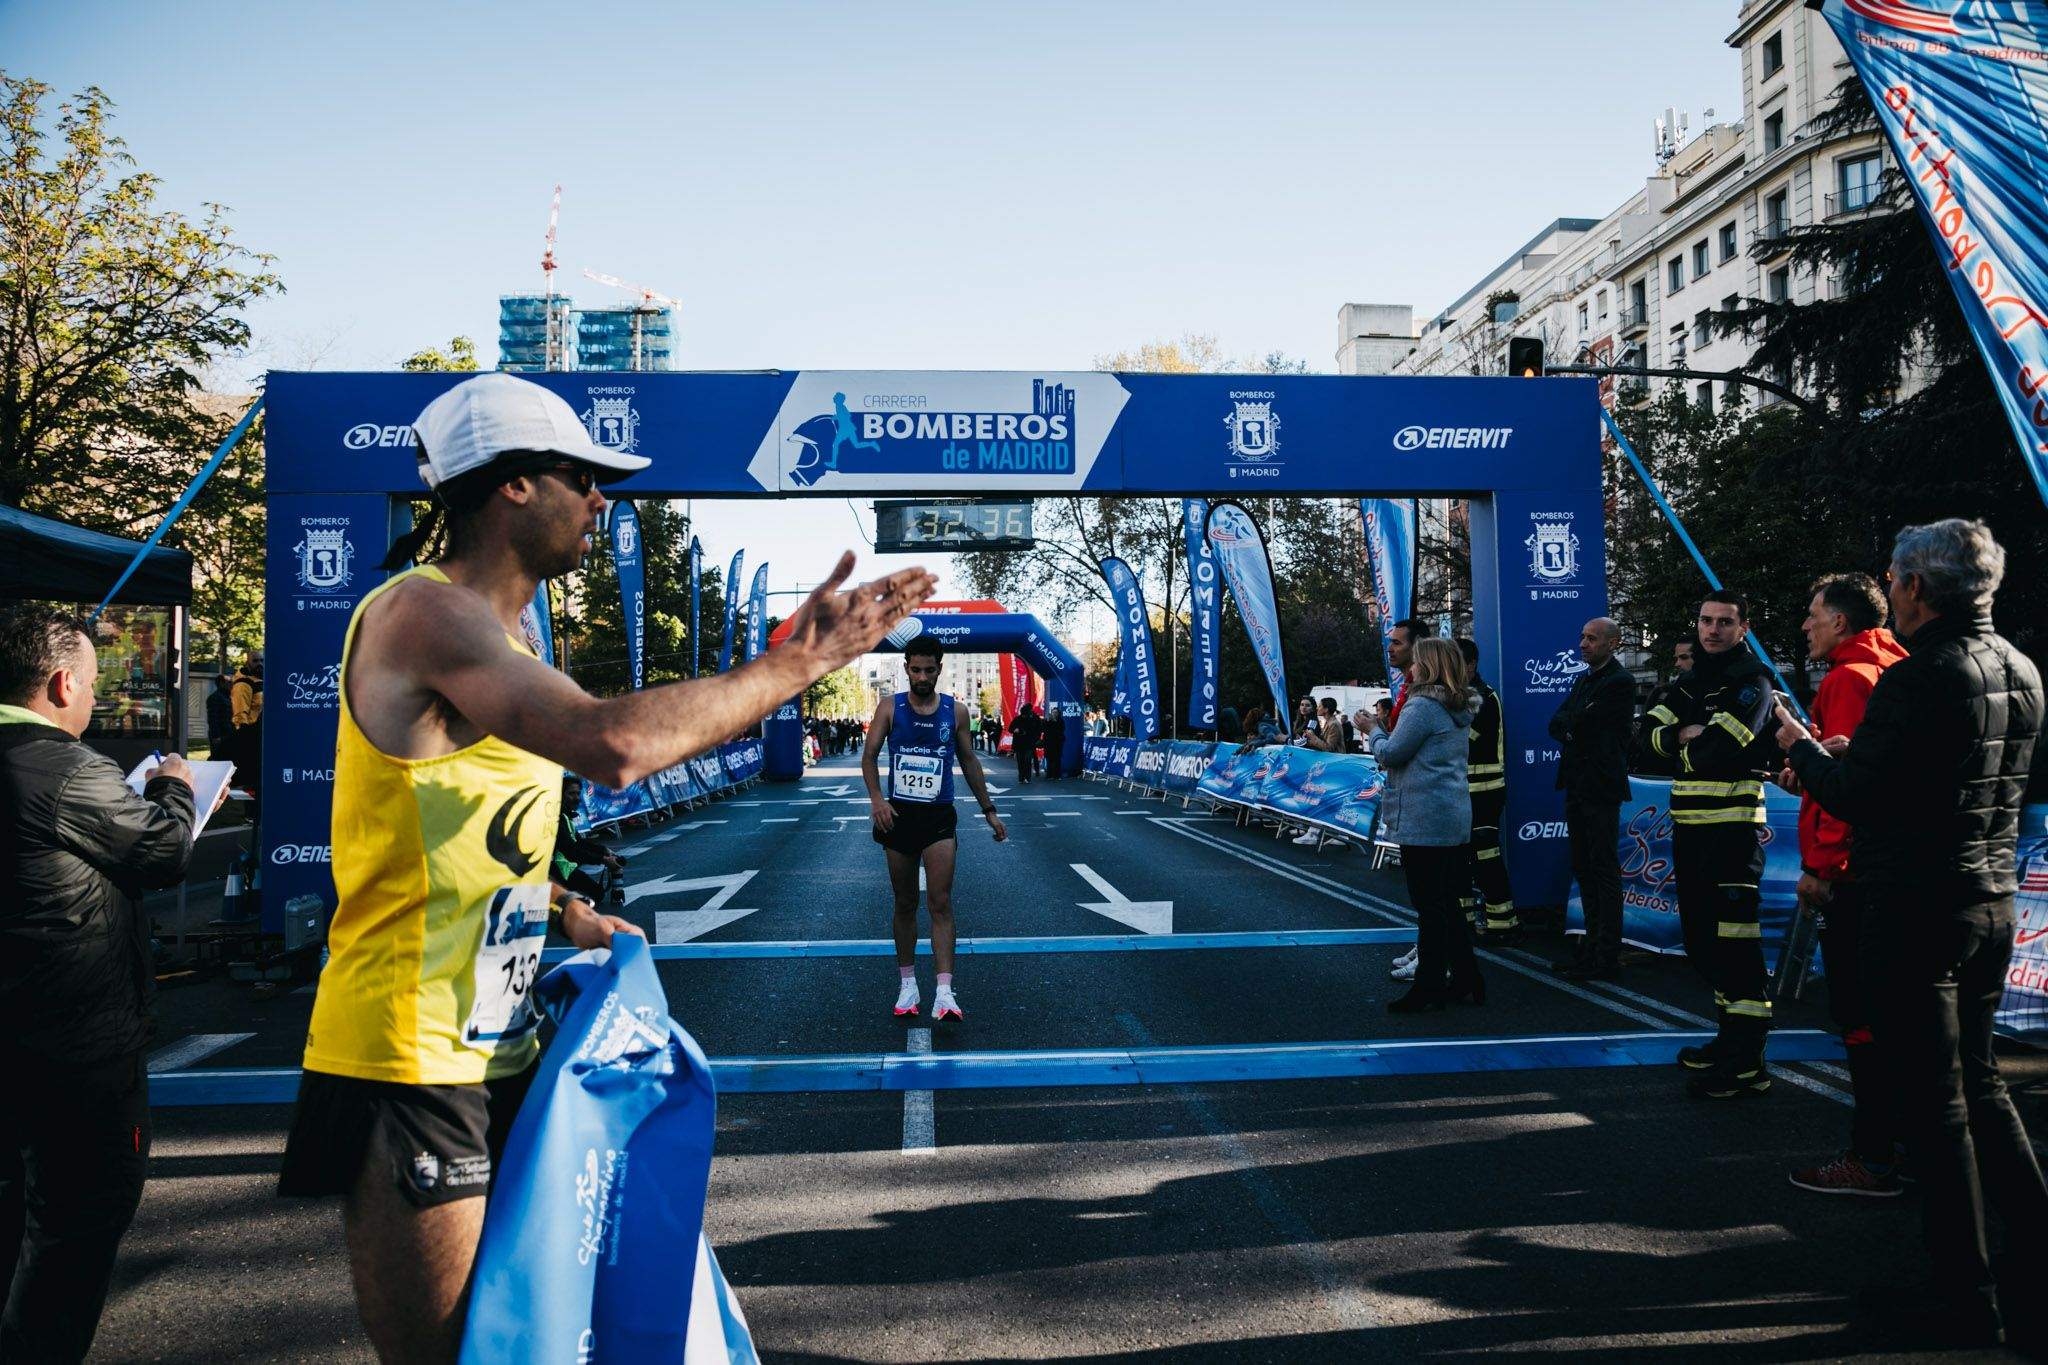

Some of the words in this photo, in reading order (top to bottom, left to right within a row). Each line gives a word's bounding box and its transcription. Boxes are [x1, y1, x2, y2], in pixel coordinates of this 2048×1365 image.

[587, 386, 635, 394] BOMBEROS
[1229, 391, 1275, 399] BOMBEROS
[863, 395, 927, 408] CARRERA
[863, 414, 1068, 440] BOMBEROS
[1426, 428, 1513, 449] ENERVIT
[942, 443, 970, 470] de
[978, 443, 1069, 470] MADRID
[1242, 468, 1280, 477] MADRID
[1530, 511, 1575, 520] BOMBEROS
[301, 517, 350, 526] BOMBEROS
[1542, 590, 1579, 599] MADRID
[310, 601, 351, 609] MADRID
[927, 627, 971, 637] +deporte
[1036, 640, 1065, 671] MADRID
[1525, 659, 1553, 674] Club
[287, 672, 319, 685] Club
[901, 773, 934, 789] 1215
